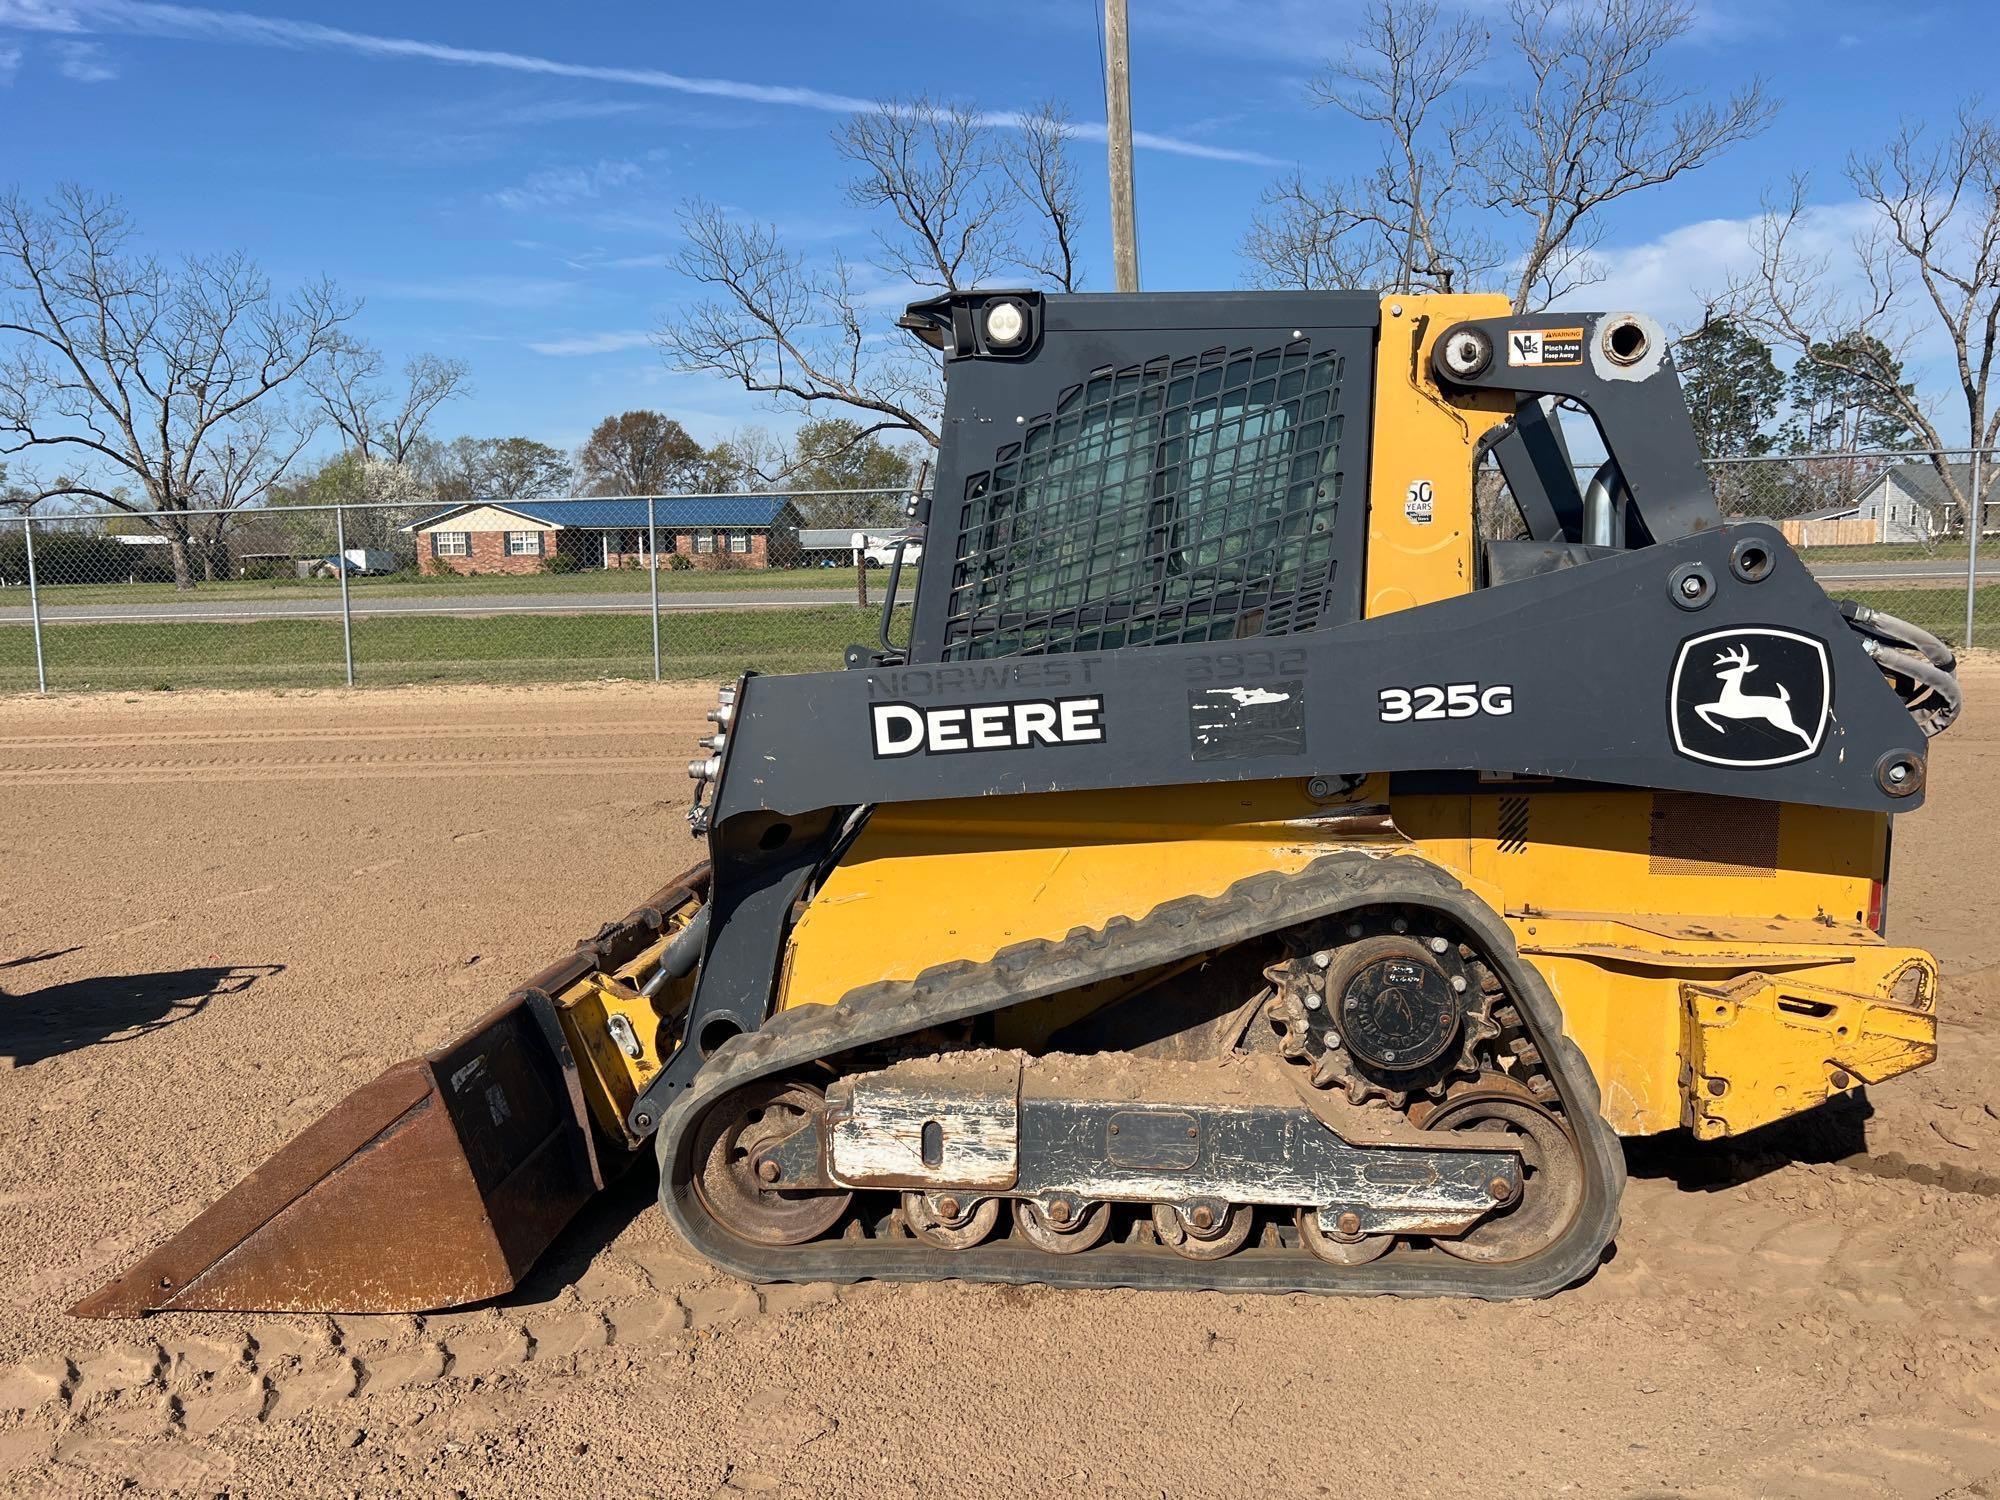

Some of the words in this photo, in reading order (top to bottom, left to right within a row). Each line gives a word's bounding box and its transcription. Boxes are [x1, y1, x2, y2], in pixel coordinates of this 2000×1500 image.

[1544, 344, 1563, 352] Pinch
[1406, 503, 1432, 511] YEARS
[867, 657, 1102, 698] NORWEST
[1380, 683, 1513, 722] 325G
[872, 698, 1103, 756] DEERE
